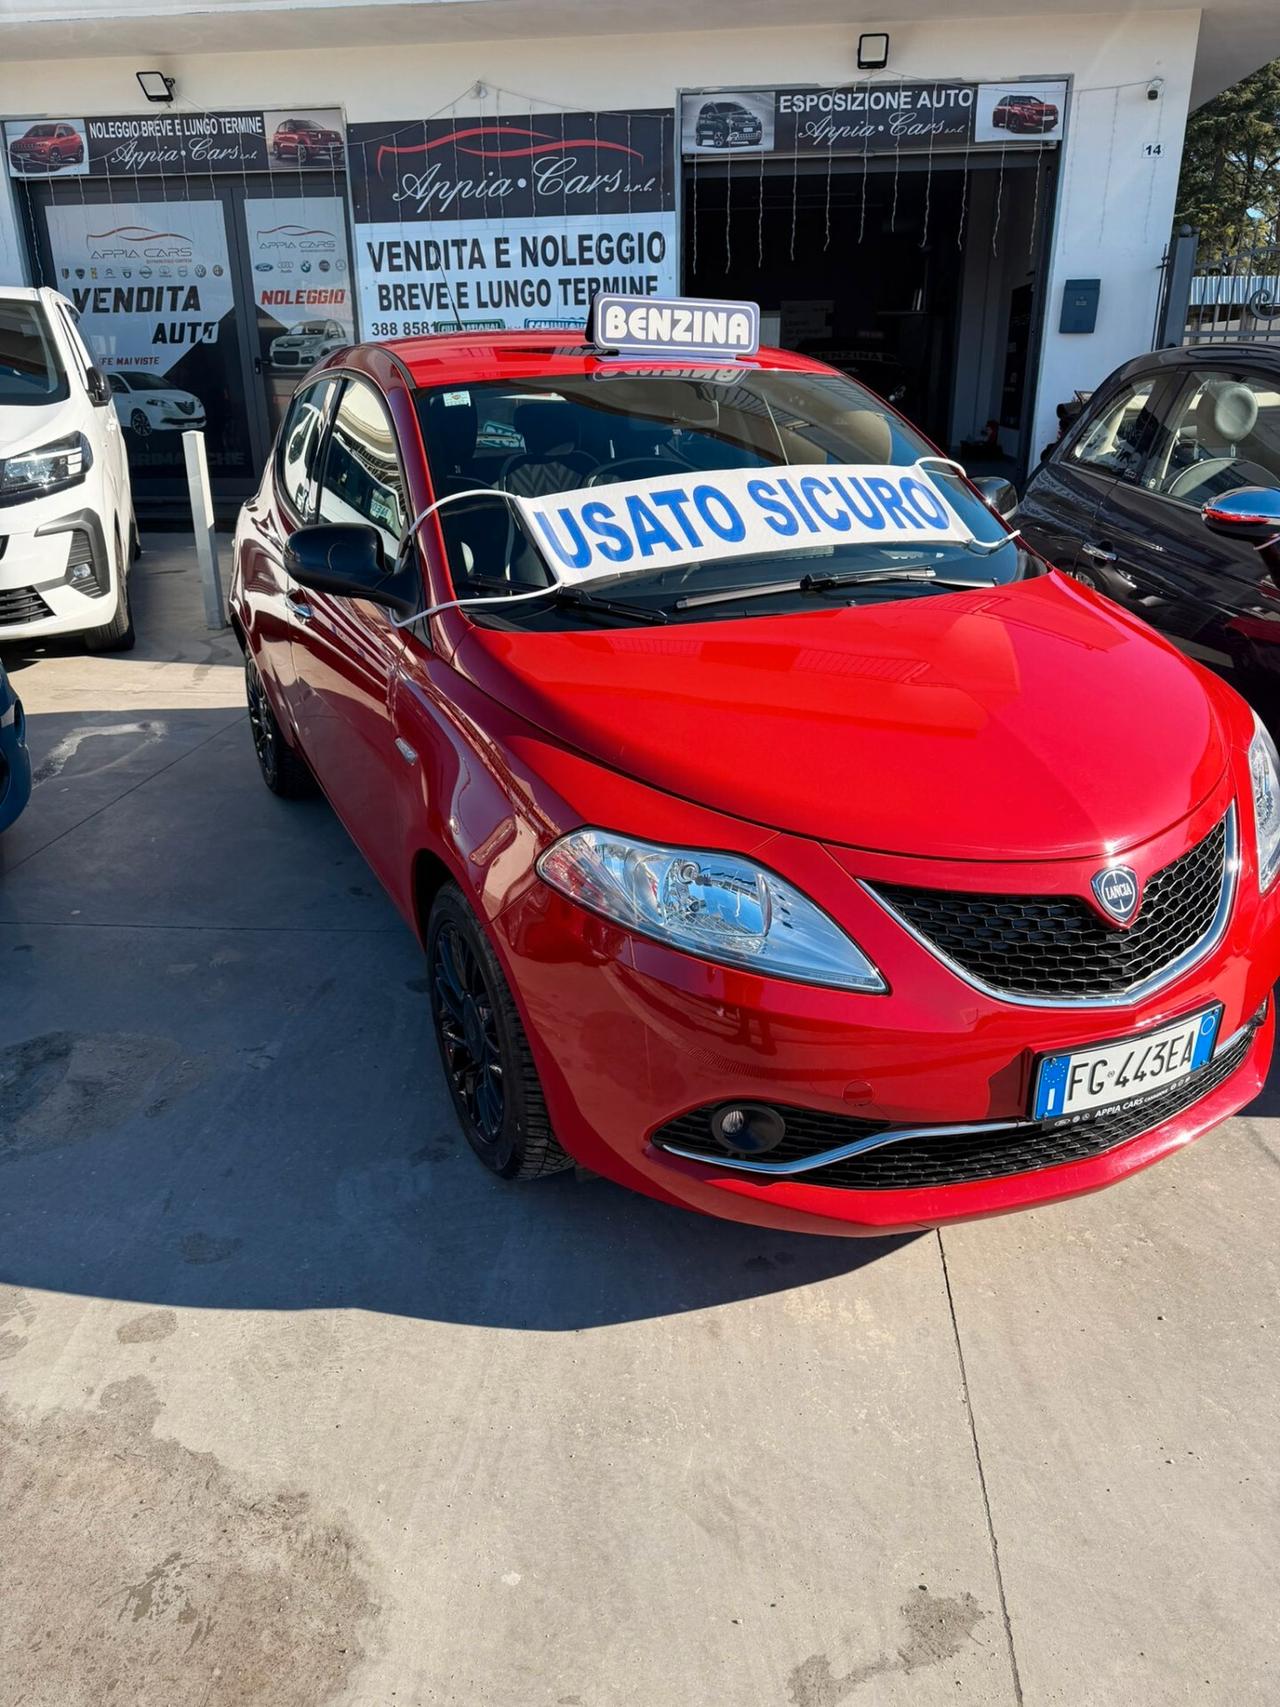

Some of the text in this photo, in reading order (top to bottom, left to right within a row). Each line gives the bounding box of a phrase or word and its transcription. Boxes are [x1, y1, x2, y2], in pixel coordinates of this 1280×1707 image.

[780, 89, 974, 113] ESPOSIZIONE AUTO
[89, 117, 263, 139] NOLEGGIO BREVE E LUNGO TERMINE
[798, 115, 875, 146] Appia
[888, 112, 945, 137] Cars
[111, 139, 179, 170] Appia
[188, 138, 239, 161] Cars
[1145, 144, 1161, 156] 14
[392, 163, 514, 213] Appia
[532, 156, 623, 196] Cars
[90, 247, 192, 259] APPIA CARS
[259, 240, 336, 249] APPIA CARS
[367, 231, 666, 272] VENDITA E NOLEGGIO
[72, 285, 201, 313] VENDITA
[261, 289, 346, 305] NOLEGGIO
[377, 281, 449, 311] BREVE
[456, 280, 470, 309] E
[476, 278, 551, 308] LUNGO
[152, 321, 219, 344] AUTO
[371, 322, 398, 336] 388
[606, 305, 749, 345] BENZINA
[116, 356, 133, 366] MAI
[134, 355, 160, 366] VISTE
[534, 476, 951, 569] USATO SICURO
[1105, 883, 1132, 900] LANCIA
[1067, 1058, 1108, 1101] FG
[1114, 1031, 1196, 1088] 443EA
[1094, 1097, 1144, 1118] APPIA CARS
